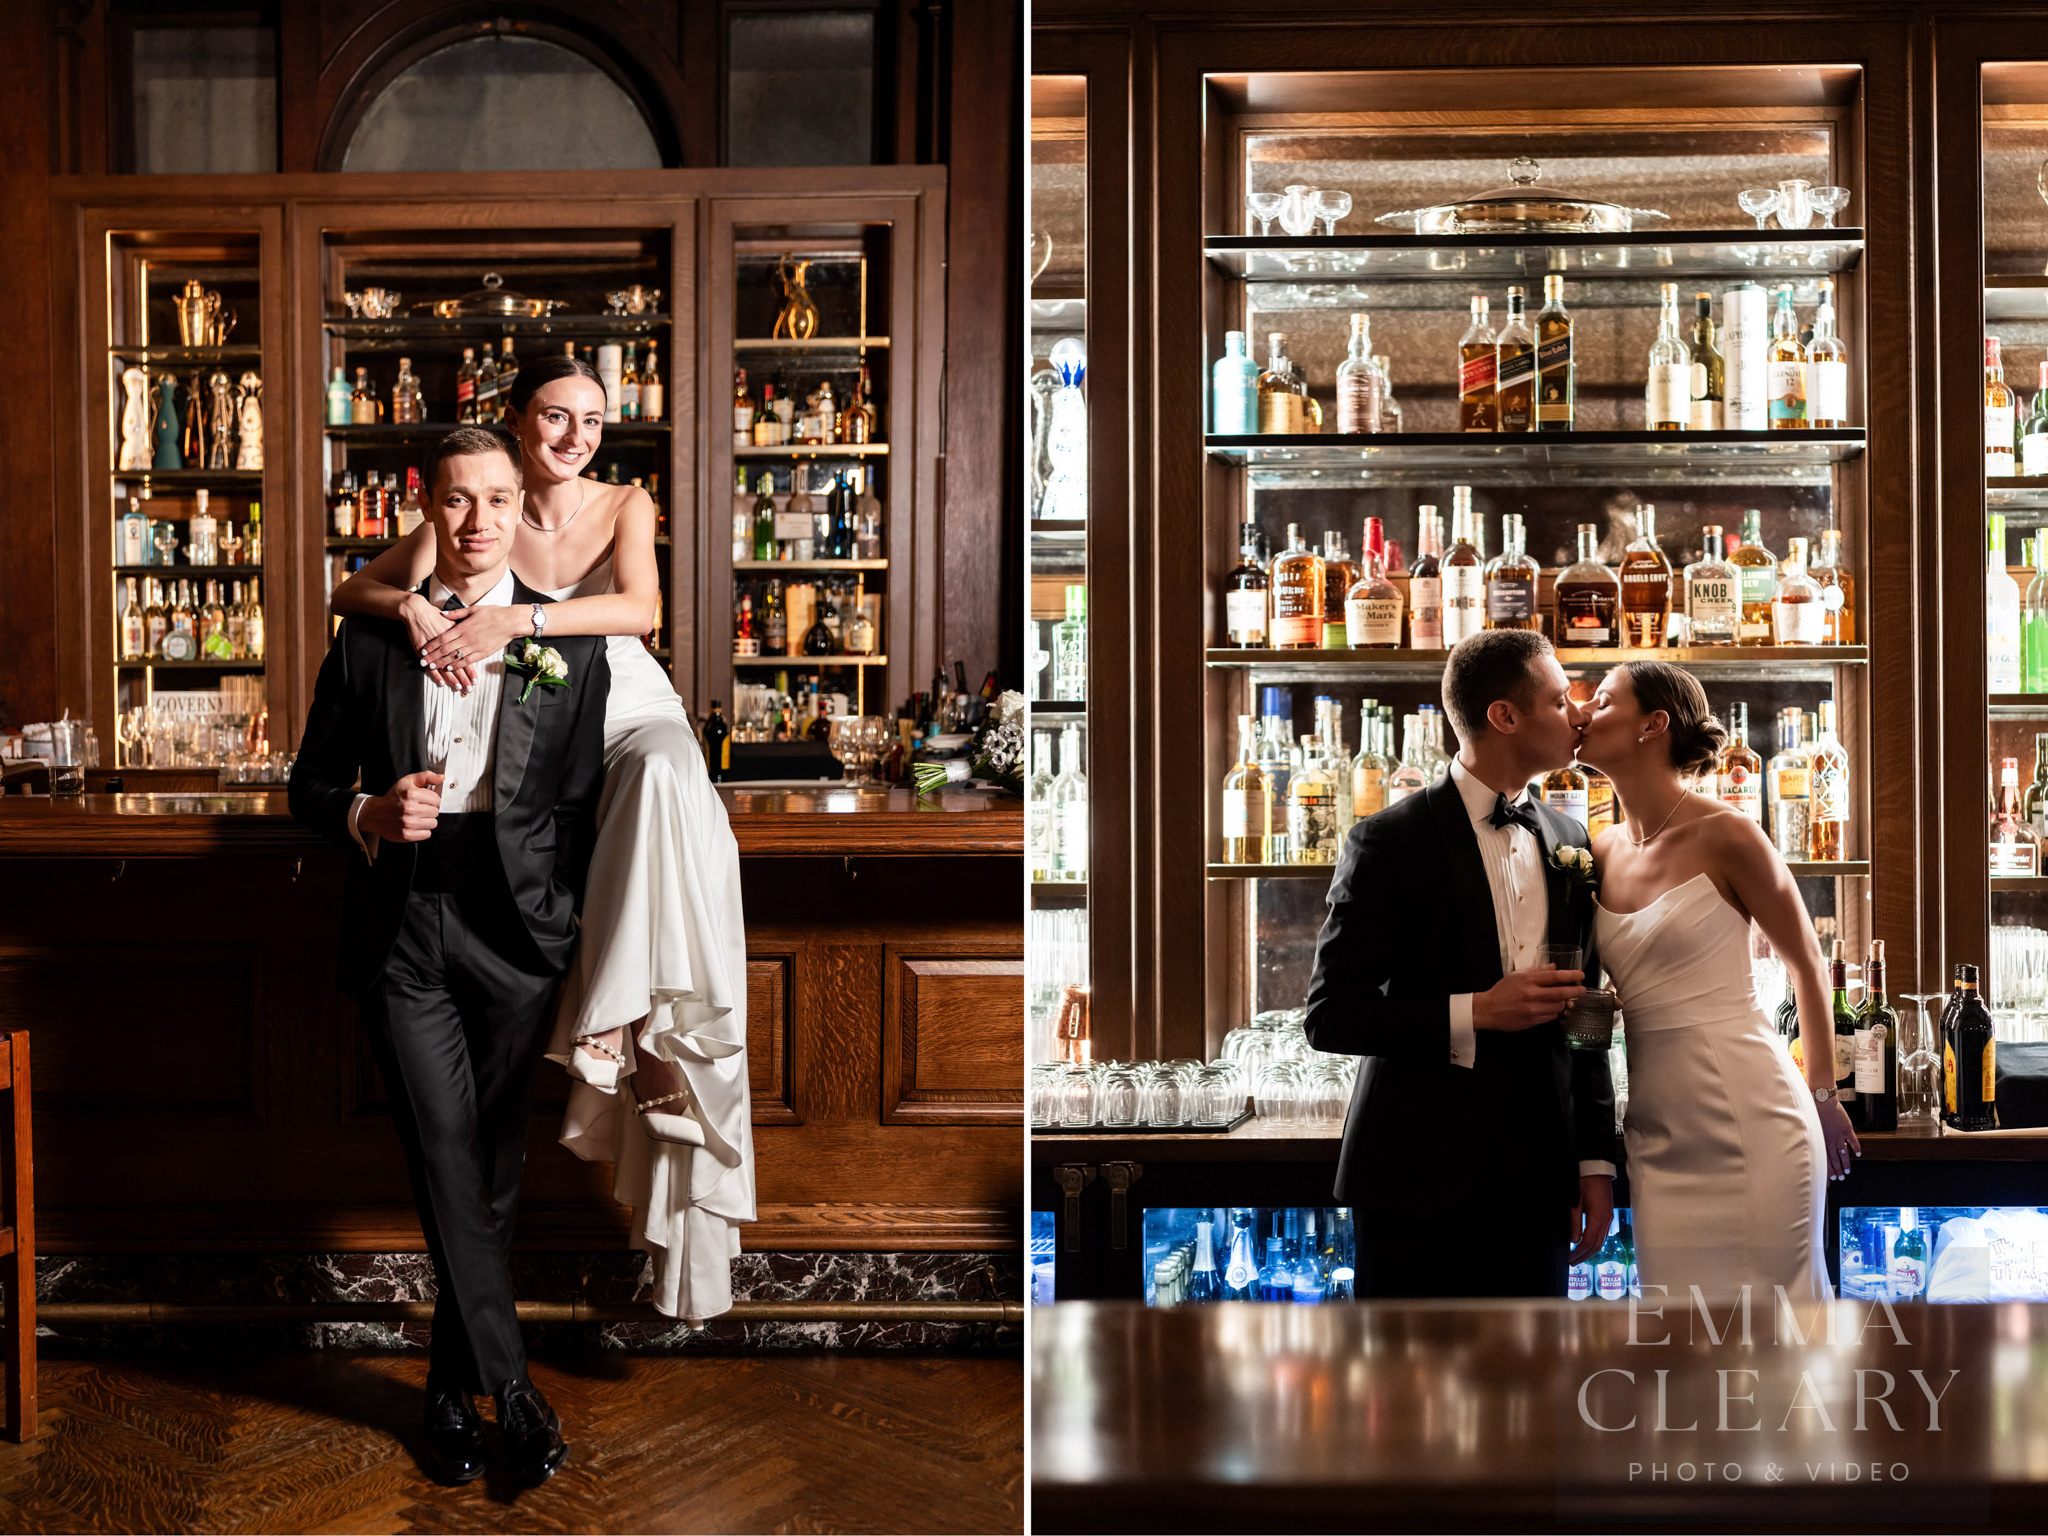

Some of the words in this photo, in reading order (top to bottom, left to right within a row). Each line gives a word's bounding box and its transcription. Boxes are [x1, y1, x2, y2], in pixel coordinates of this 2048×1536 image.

[1694, 583, 1728, 598] KNOB
[1356, 602, 1397, 611] Maker's
[1366, 611, 1397, 620] Mark
